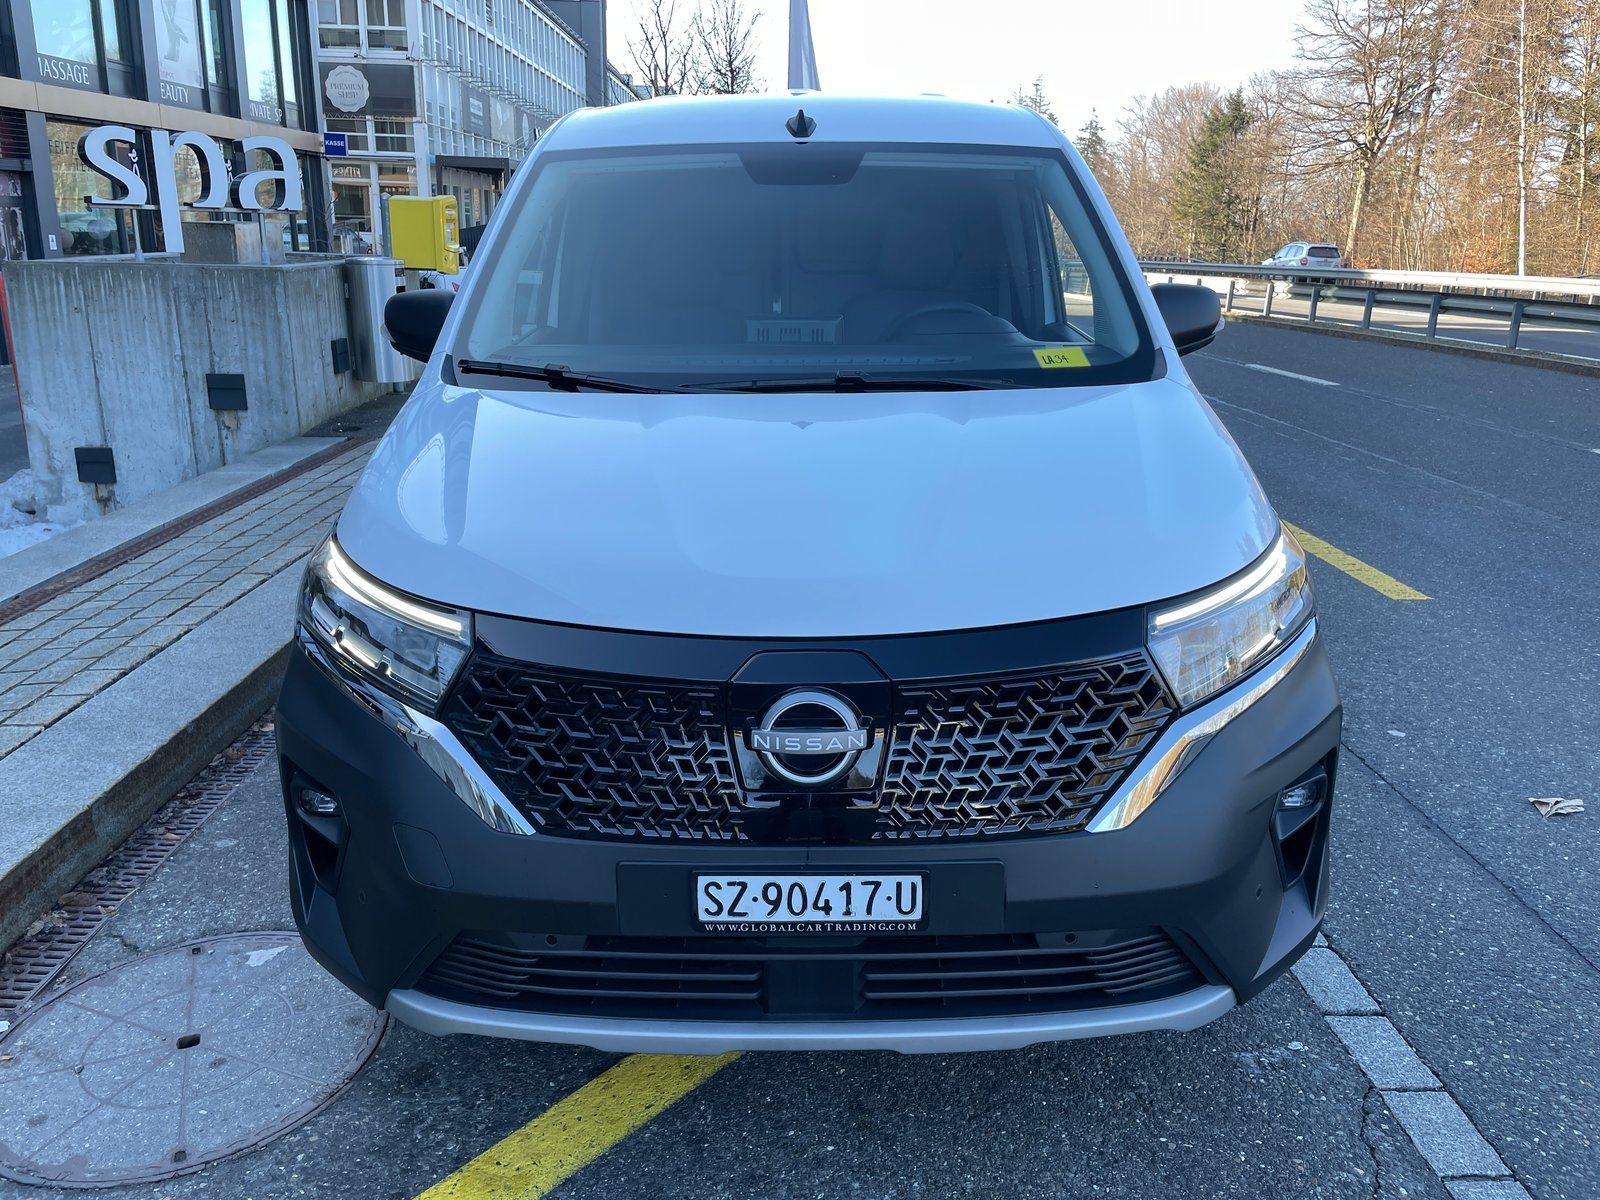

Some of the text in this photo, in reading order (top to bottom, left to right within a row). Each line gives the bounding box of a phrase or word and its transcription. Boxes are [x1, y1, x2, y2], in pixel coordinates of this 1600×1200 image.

[325, 139, 345, 148] KASSE
[77, 125, 303, 253] spa
[753, 733, 865, 751] NISSAN
